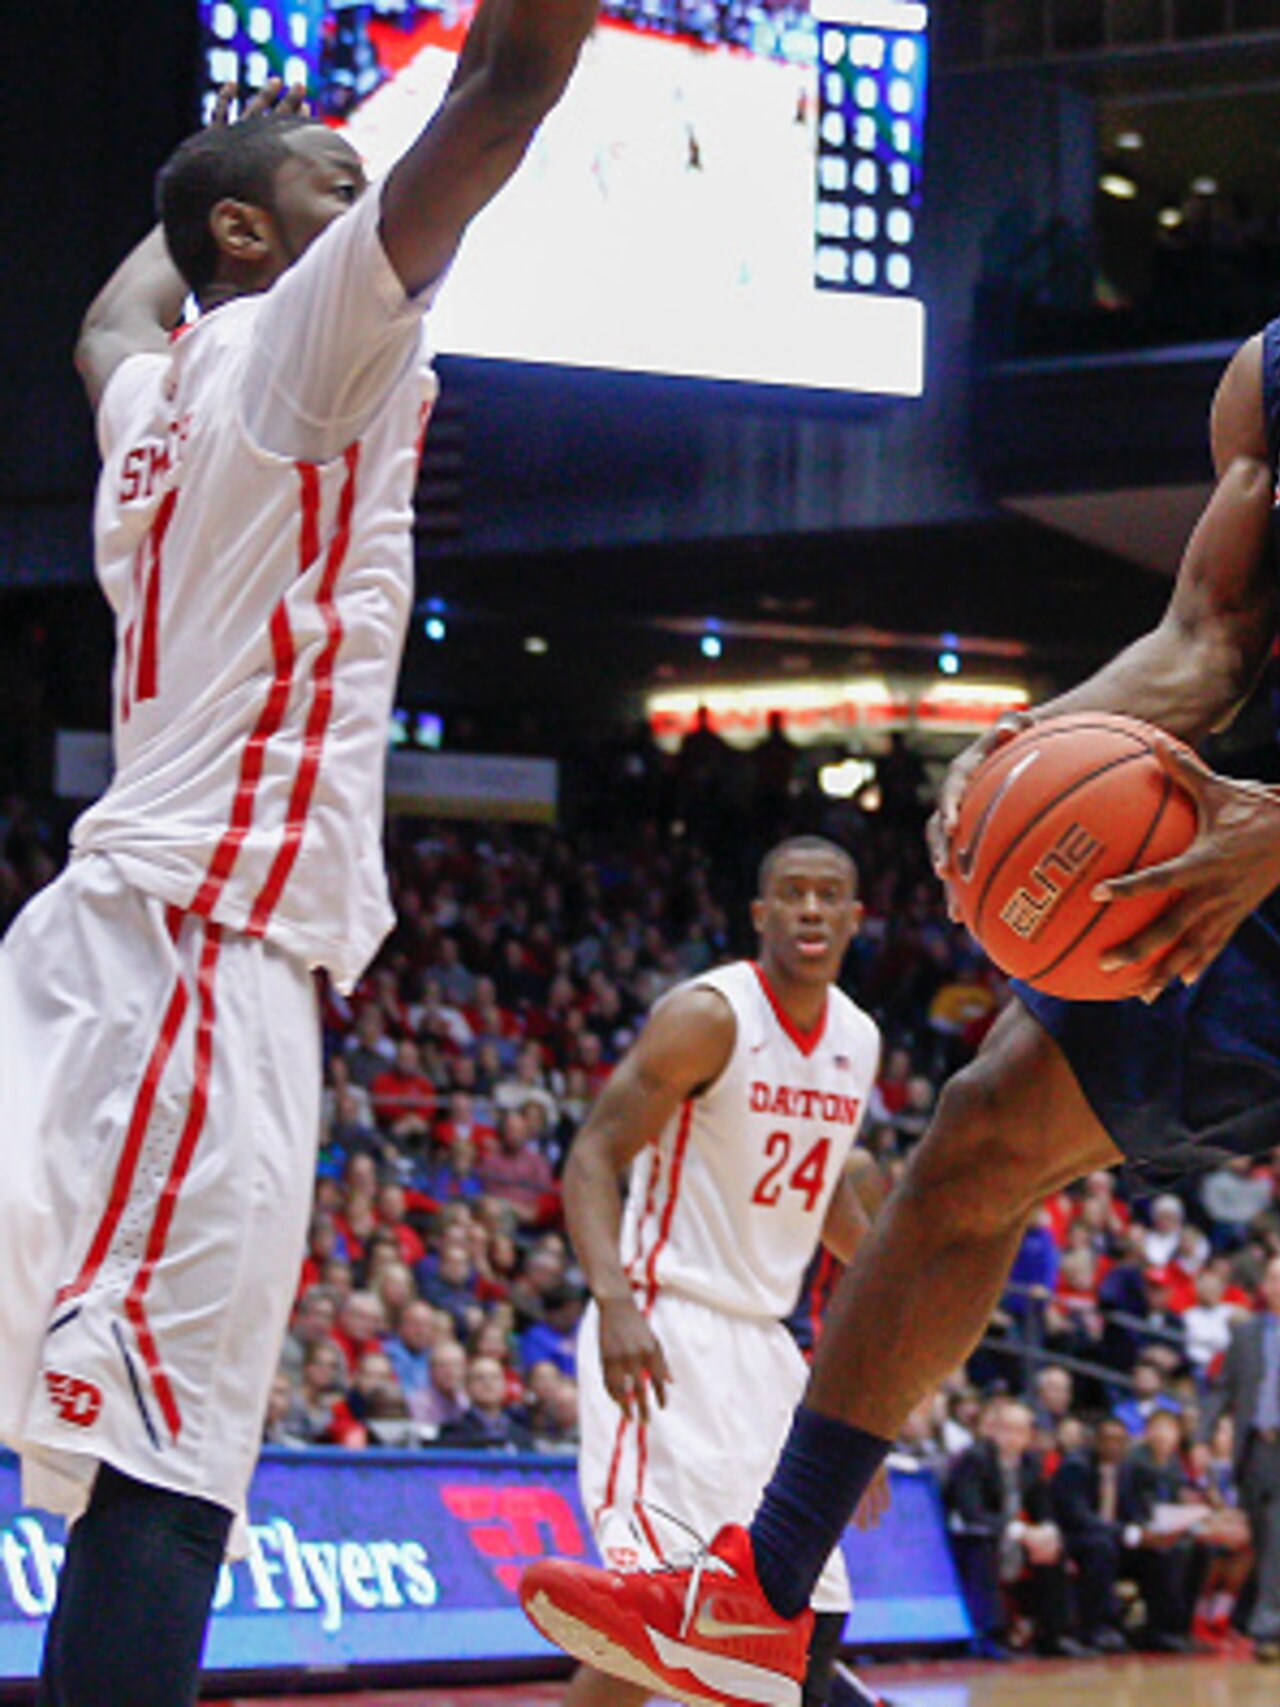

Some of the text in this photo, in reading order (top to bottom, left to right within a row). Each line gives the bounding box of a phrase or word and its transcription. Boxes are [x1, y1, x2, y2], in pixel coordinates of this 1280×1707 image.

[1000, 821, 1099, 940] ELITE
[751, 1131, 832, 1213] 24
[1, 1516, 66, 1616] th
[246, 1516, 437, 1632] Flyers
